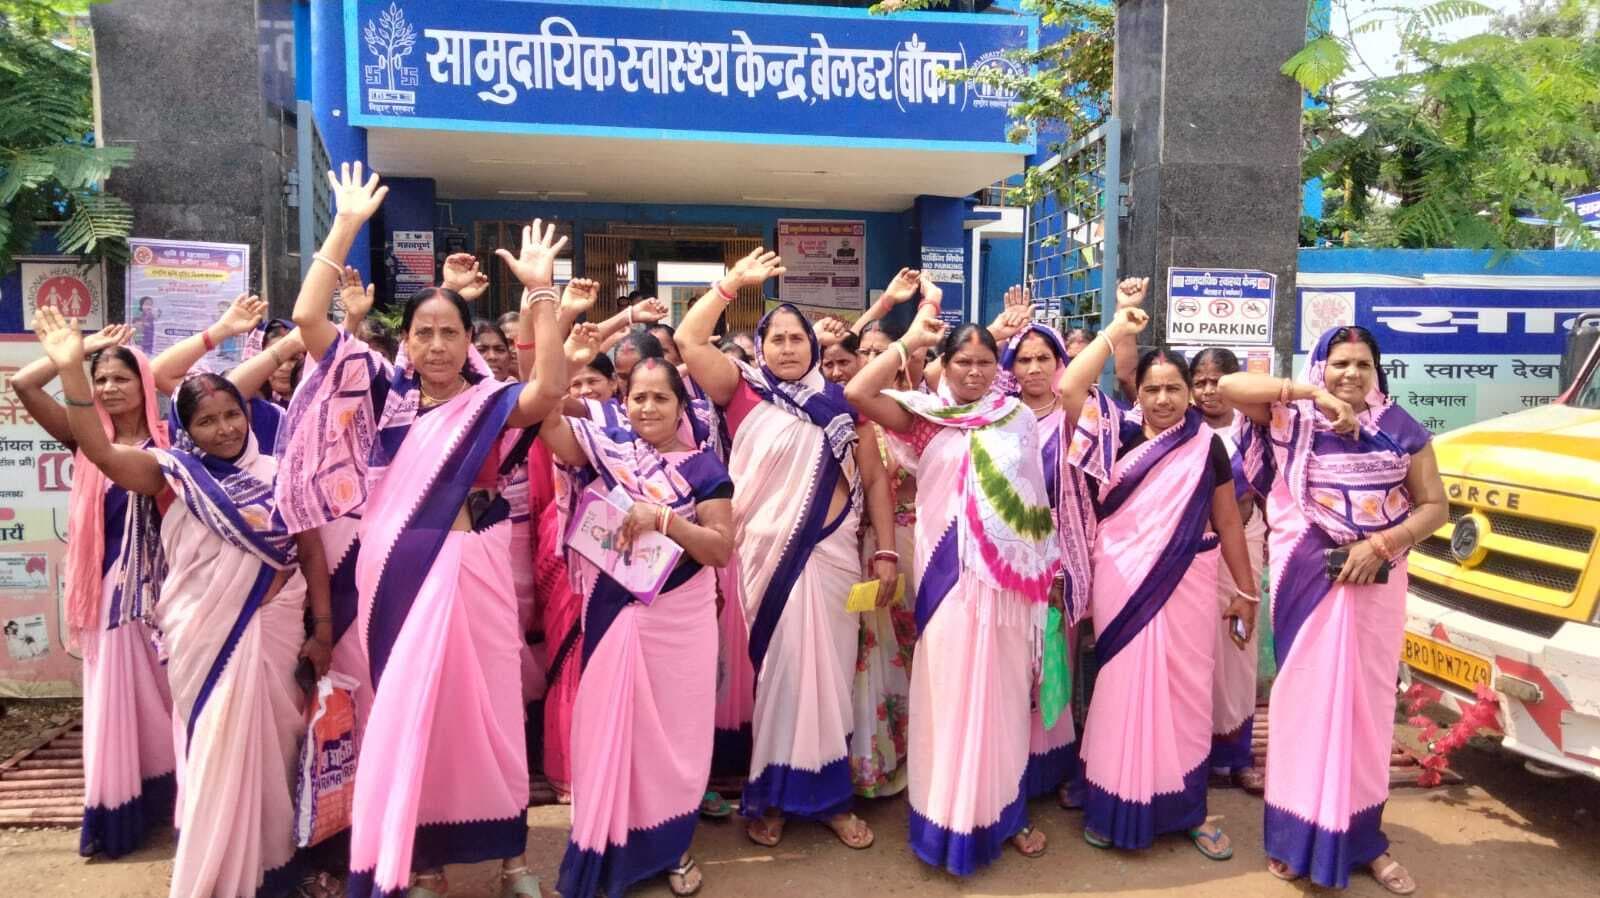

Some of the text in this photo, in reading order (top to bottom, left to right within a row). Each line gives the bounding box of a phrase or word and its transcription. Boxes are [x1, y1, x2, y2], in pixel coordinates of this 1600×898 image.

[424, 16, 615, 105] सामुदायिक
[617, 38, 728, 97] स्वास्थ्य
[1172, 321, 1268, 336] NO PARKING
[1511, 359, 1561, 379] देख
[1408, 391, 1469, 407] देखभाल
[1448, 483, 1521, 510] ORCE
